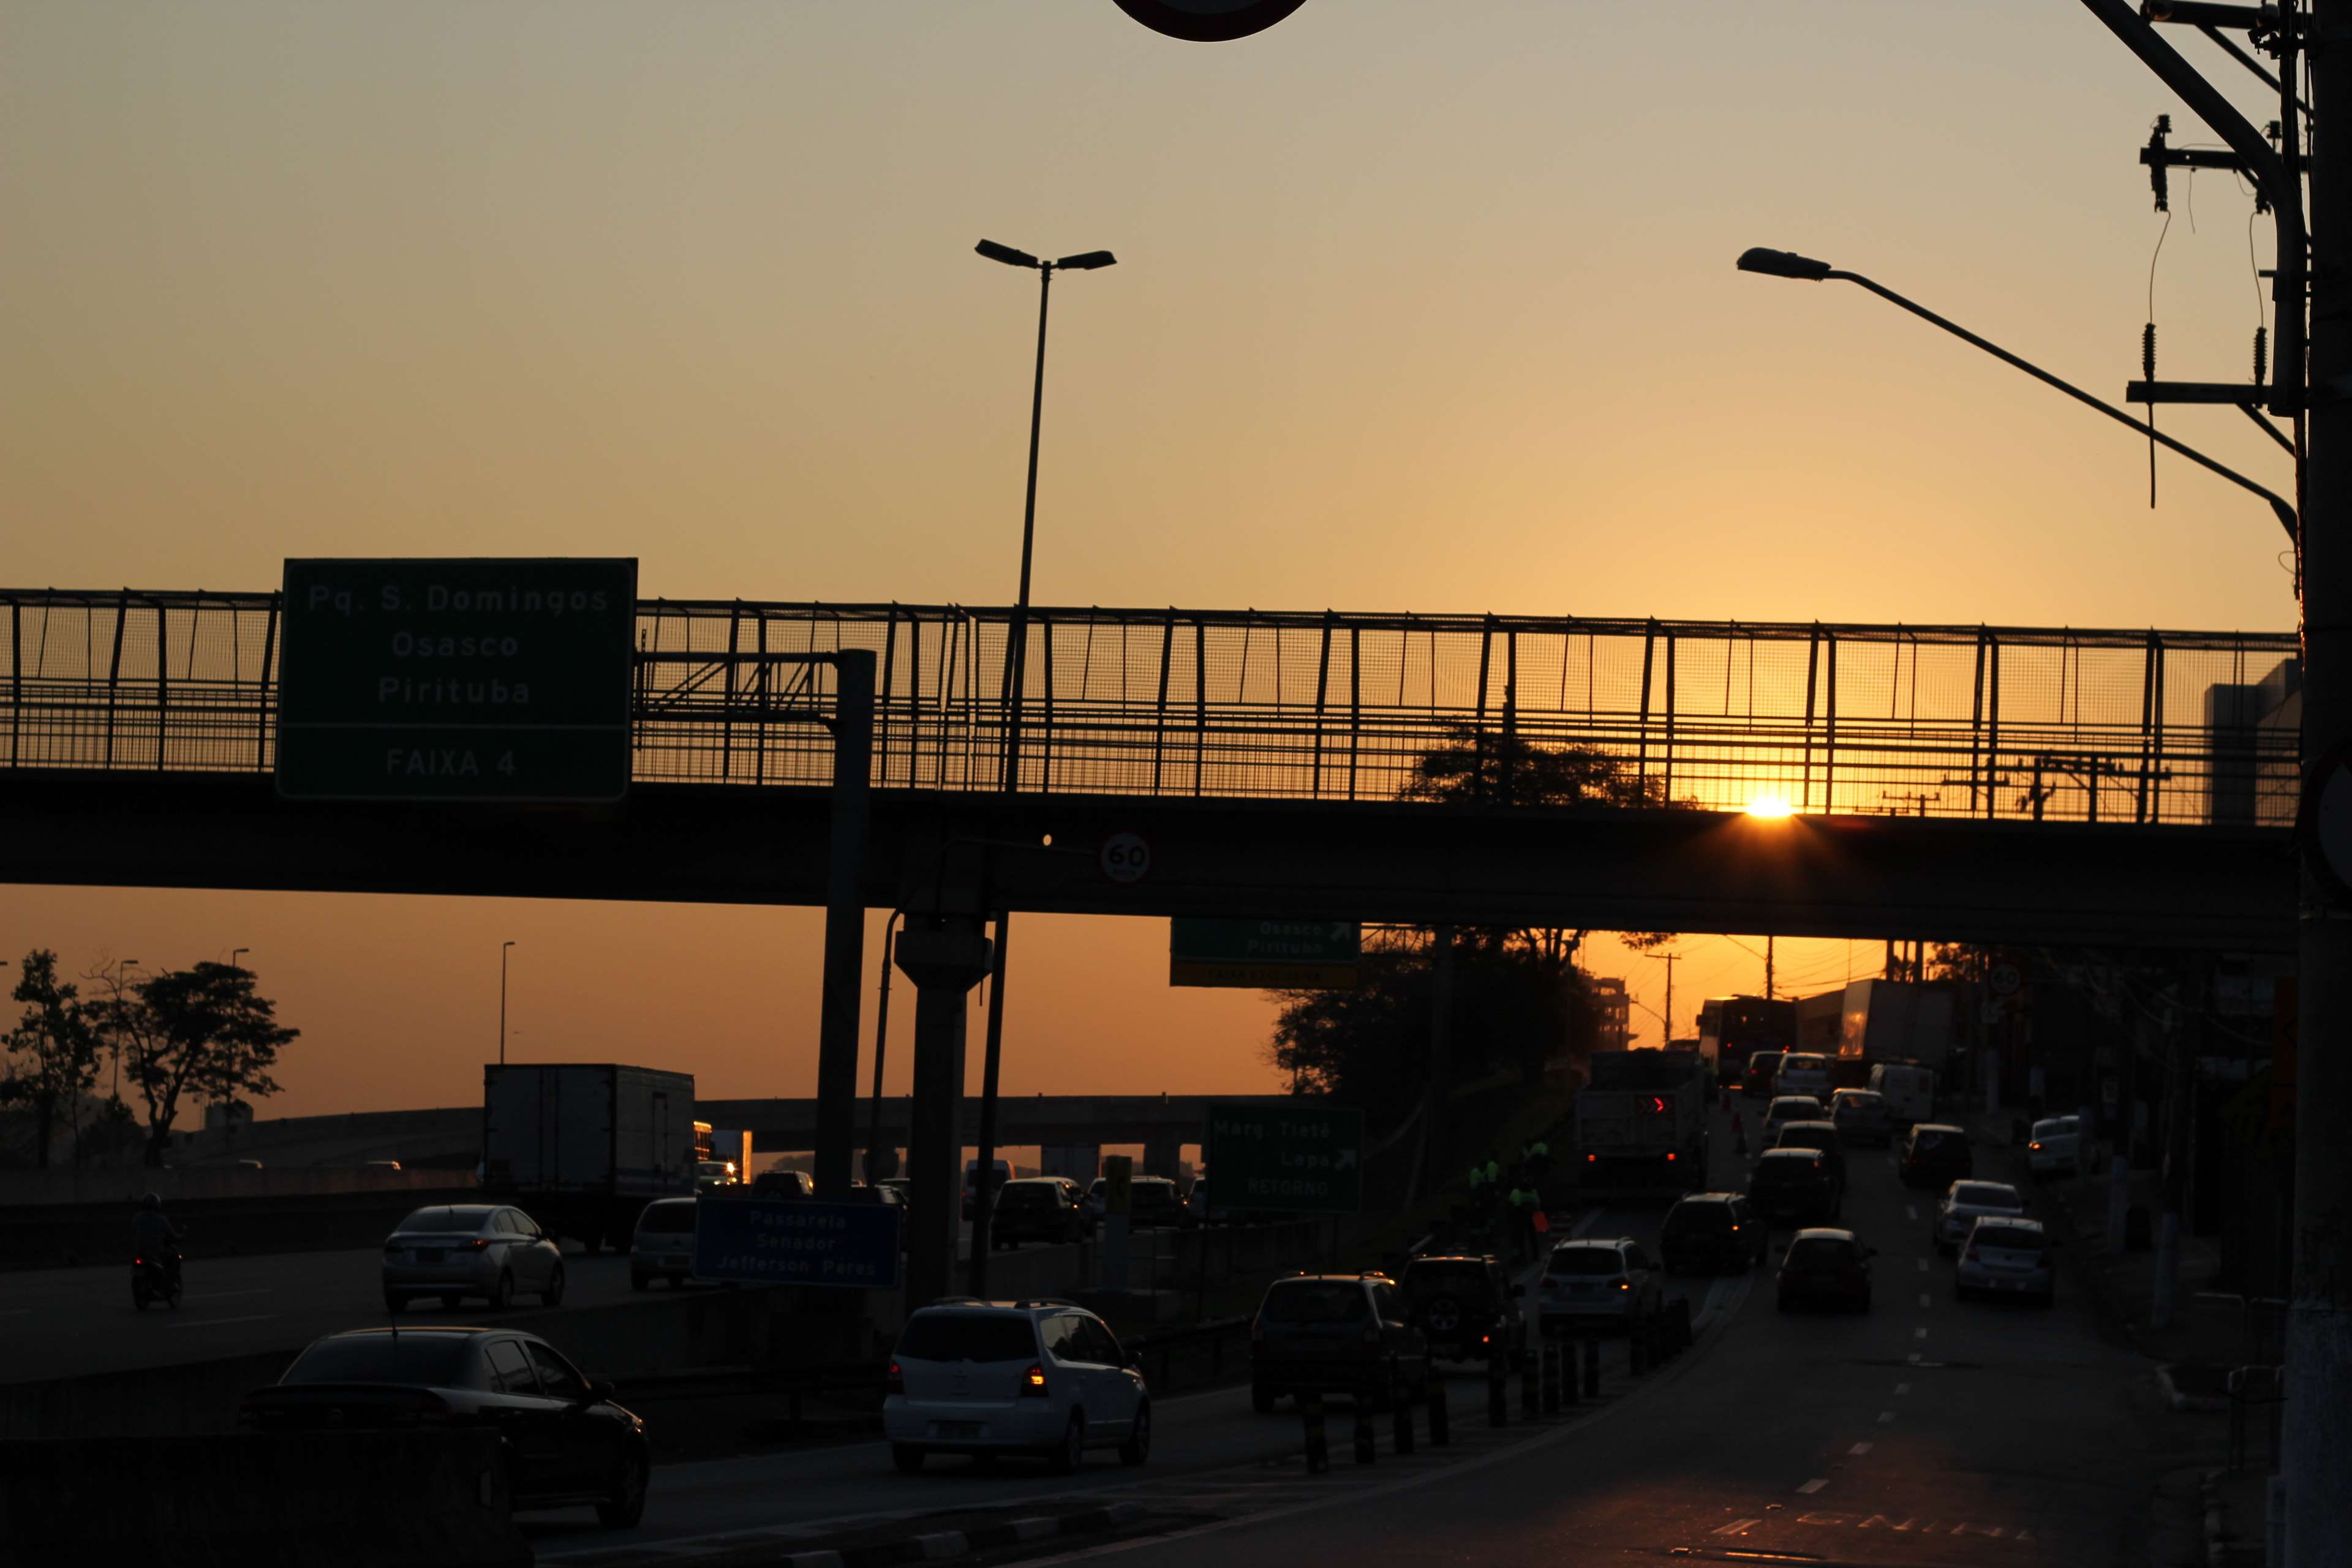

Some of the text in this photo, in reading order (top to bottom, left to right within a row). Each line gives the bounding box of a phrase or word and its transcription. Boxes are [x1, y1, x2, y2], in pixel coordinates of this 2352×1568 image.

[309, 585, 608, 616] Pq. S. Domingos
[391, 632, 519, 657] Osasco
[379, 677, 530, 704] Pirituba
[387, 749, 516, 776] FAIXA 4
[1109, 844, 1145, 866] 60
[1260, 921, 1324, 937] Osasco
[1248, 939, 1324, 954] Pirituba
[1214, 1120, 1270, 1140] Marg.
[1281, 1151, 1330, 1169] Lapa
[1246, 1177, 1329, 1196] RETORNO
[750, 1210, 846, 1229] Passarela
[756, 1233, 836, 1250] Senador
[716, 1254, 810, 1273] Jefferson
